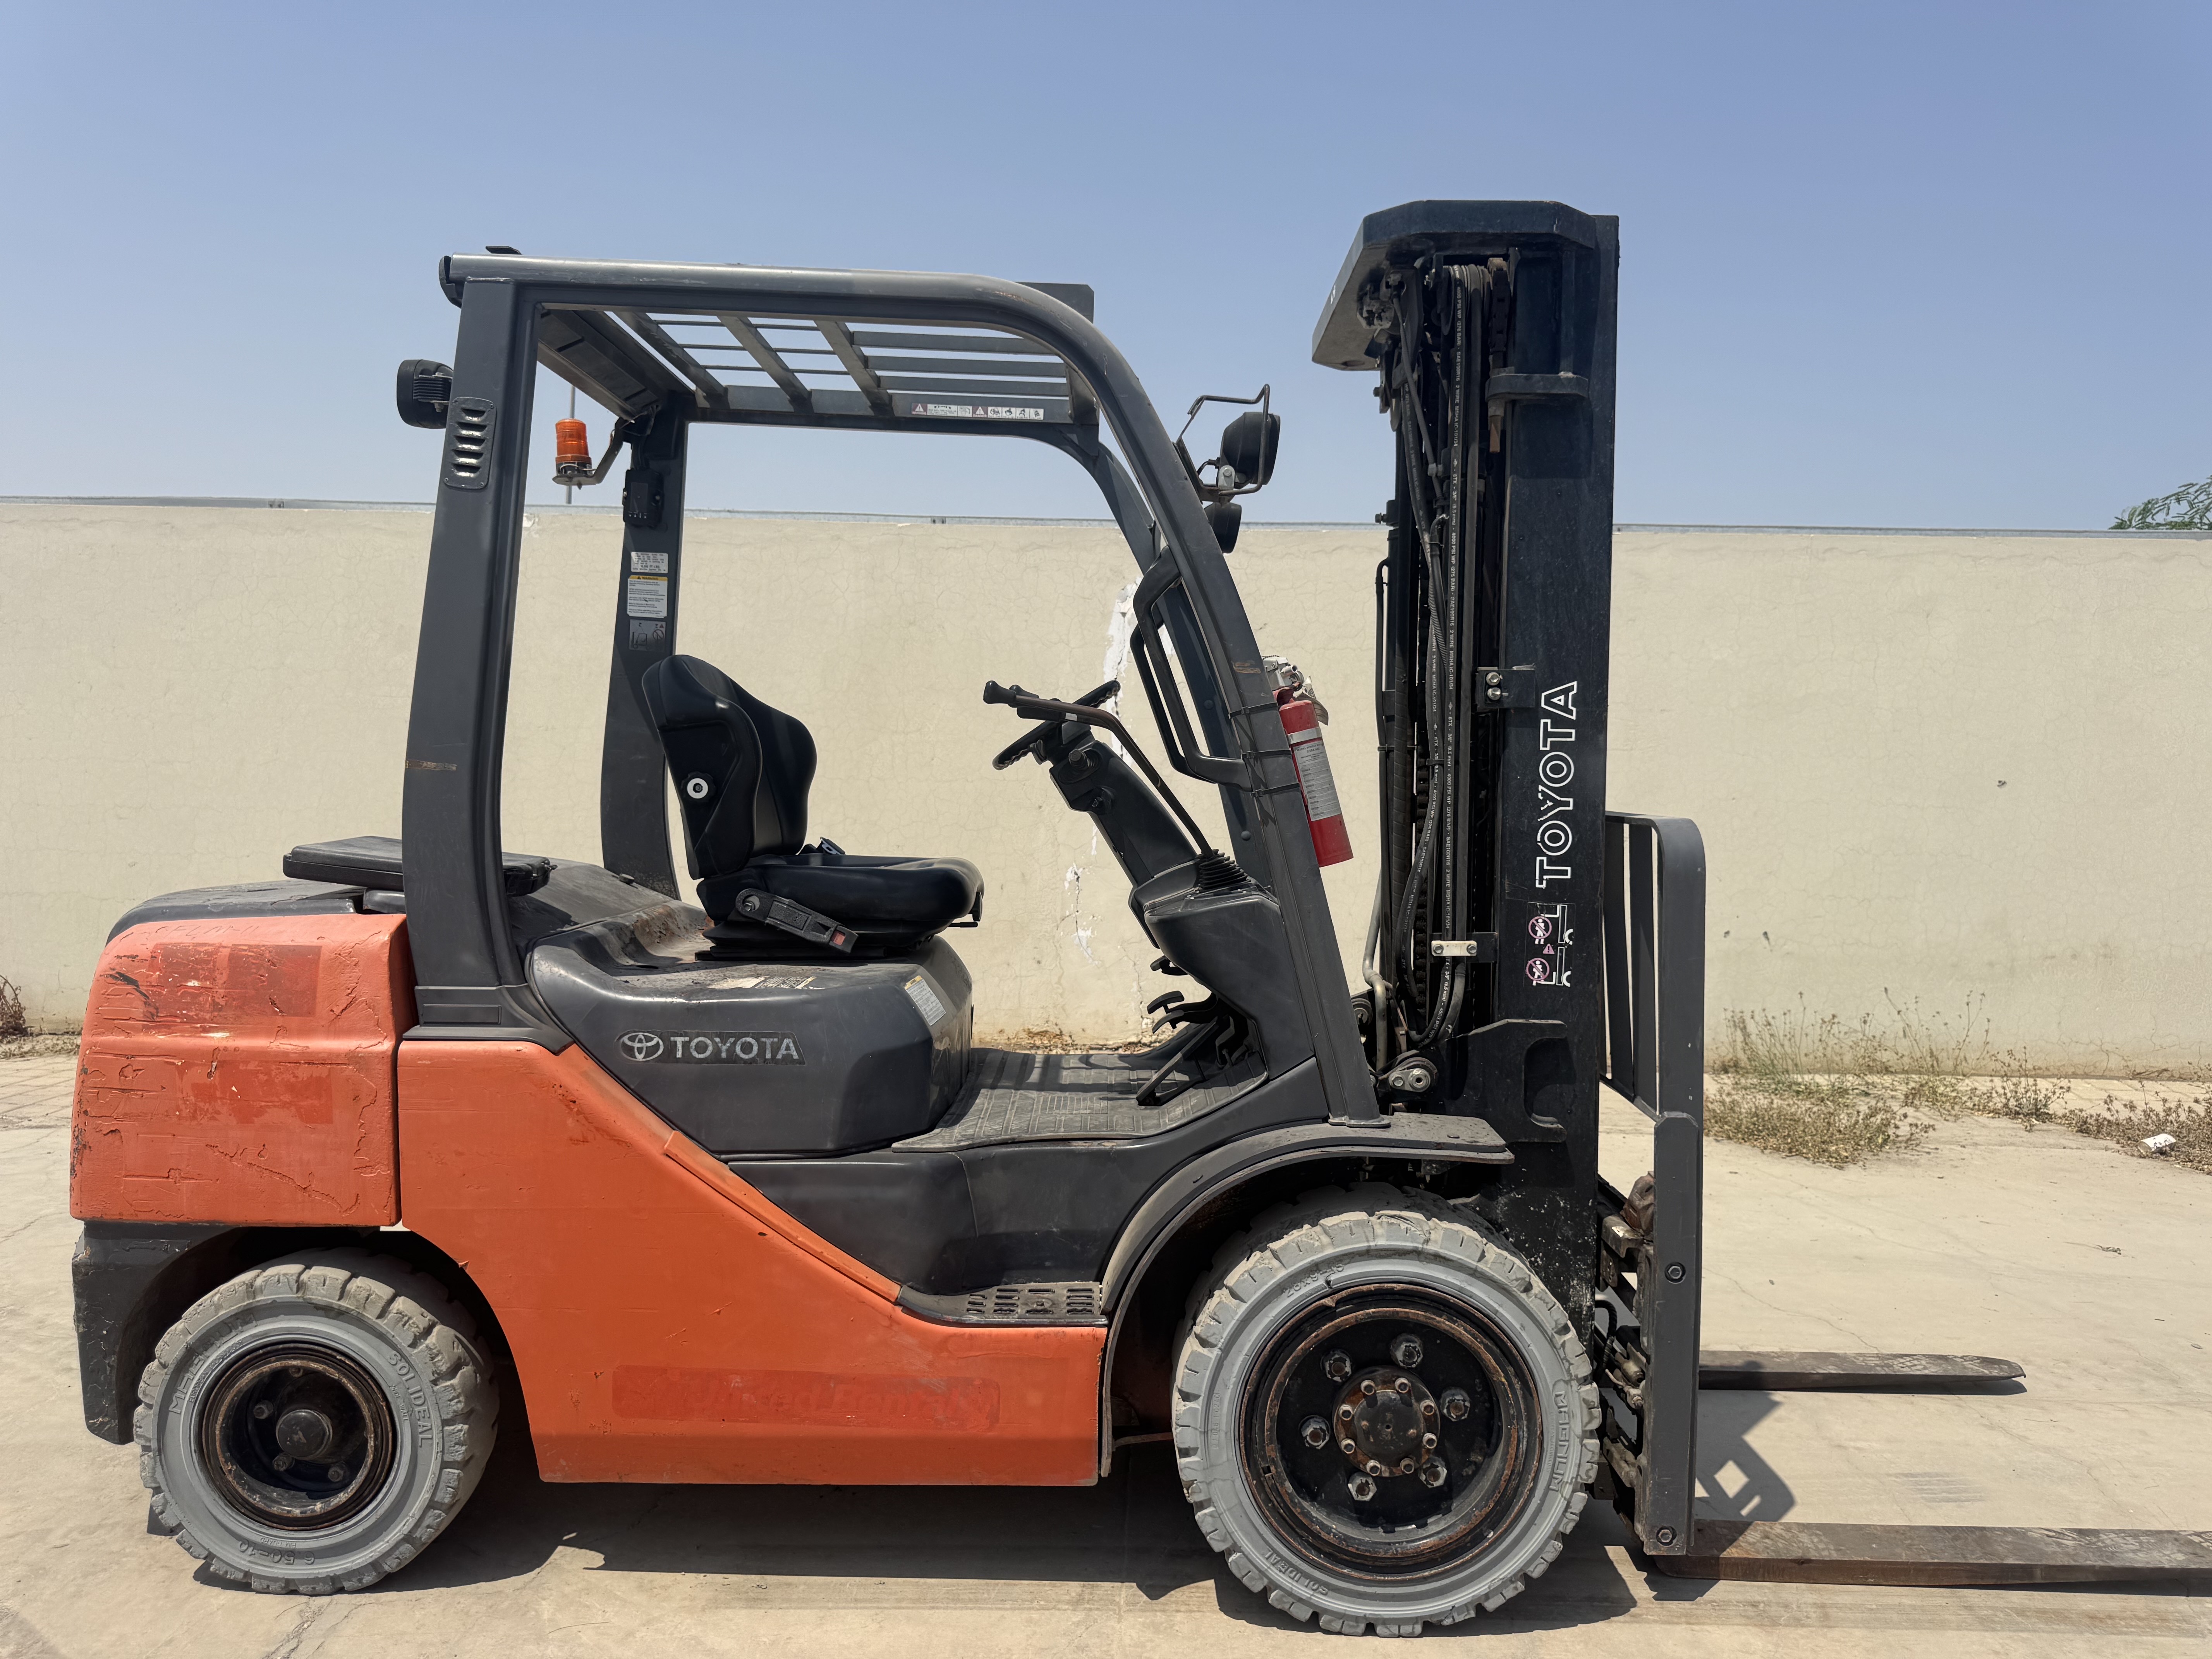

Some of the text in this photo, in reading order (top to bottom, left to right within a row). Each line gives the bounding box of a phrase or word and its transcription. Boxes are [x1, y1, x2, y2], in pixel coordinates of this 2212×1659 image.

[1456, 309, 1462, 319] WP
[1450, 555, 1455, 564] WP
[1535, 681, 1577, 888] TOYOTA
[1446, 795, 1451, 804] WP
[670, 1037, 799, 1059] TOYOTA
[388, 1351, 431, 1448] SOLIDEAL
[1548, 1390, 1570, 1493] MAGNUM
[259, 1536, 283, 1547] GUARD
[1261, 1547, 1329, 1597] SOLIDEAL
